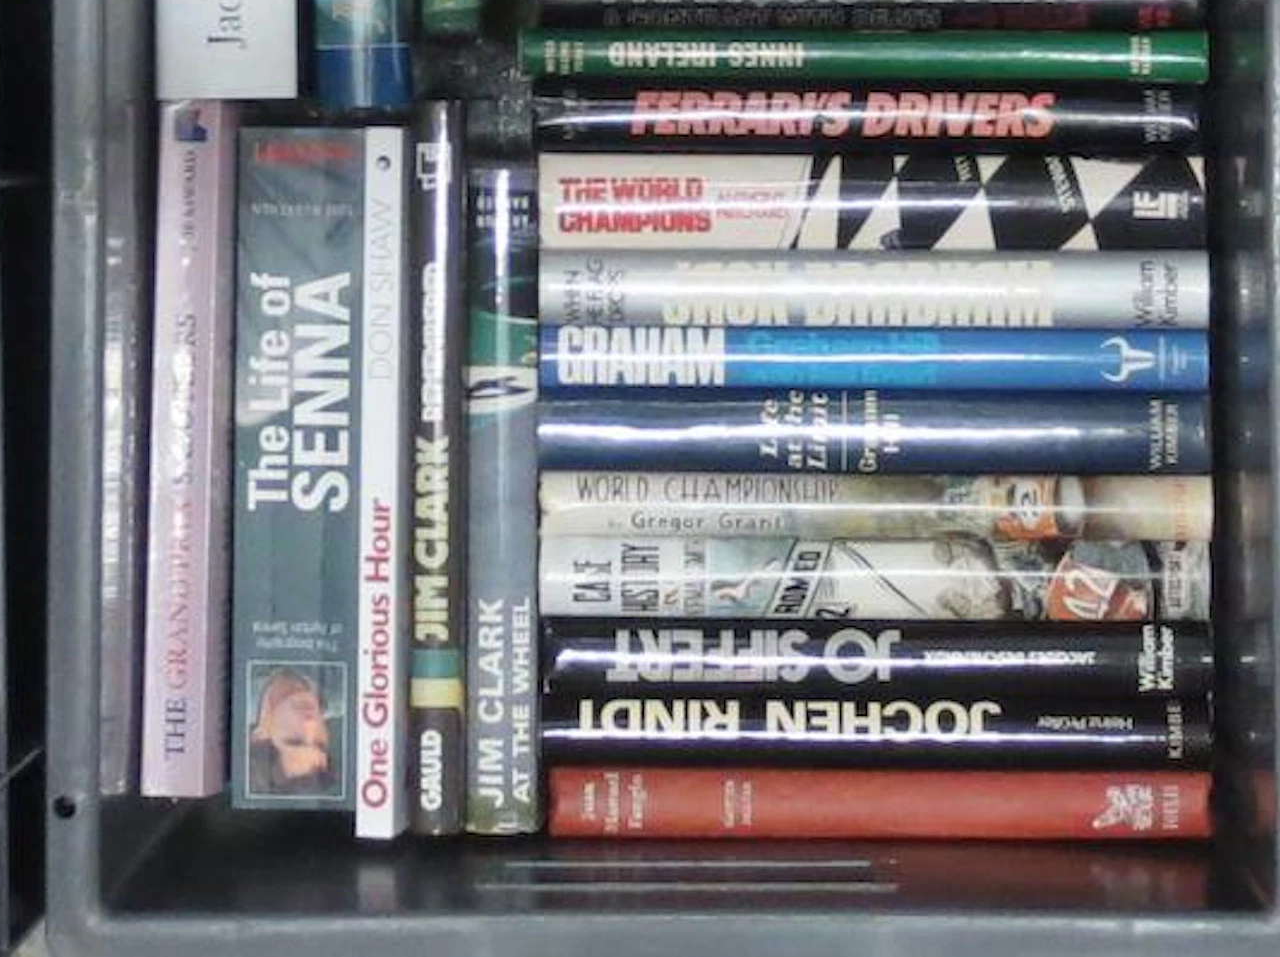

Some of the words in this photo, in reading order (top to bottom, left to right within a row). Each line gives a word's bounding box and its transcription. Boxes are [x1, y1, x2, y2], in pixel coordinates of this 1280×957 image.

[629, 91, 852, 136] FERRARI'S
[860, 91, 1057, 138] DRIVERS
[250, 273, 291, 324] of
[248, 331, 291, 414] Life
[292, 272, 352, 513] SENNA
[248, 424, 289, 511] The
[365, 498, 391, 567] Hour
[363, 587, 392, 725] Glorious
[475, 597, 505, 737] CLARK
[579, 699, 740, 738] RINDT
[766, 700, 1002, 743] JOCHEN
[363, 738, 388, 810] One
[473, 752, 504, 808] JIM
